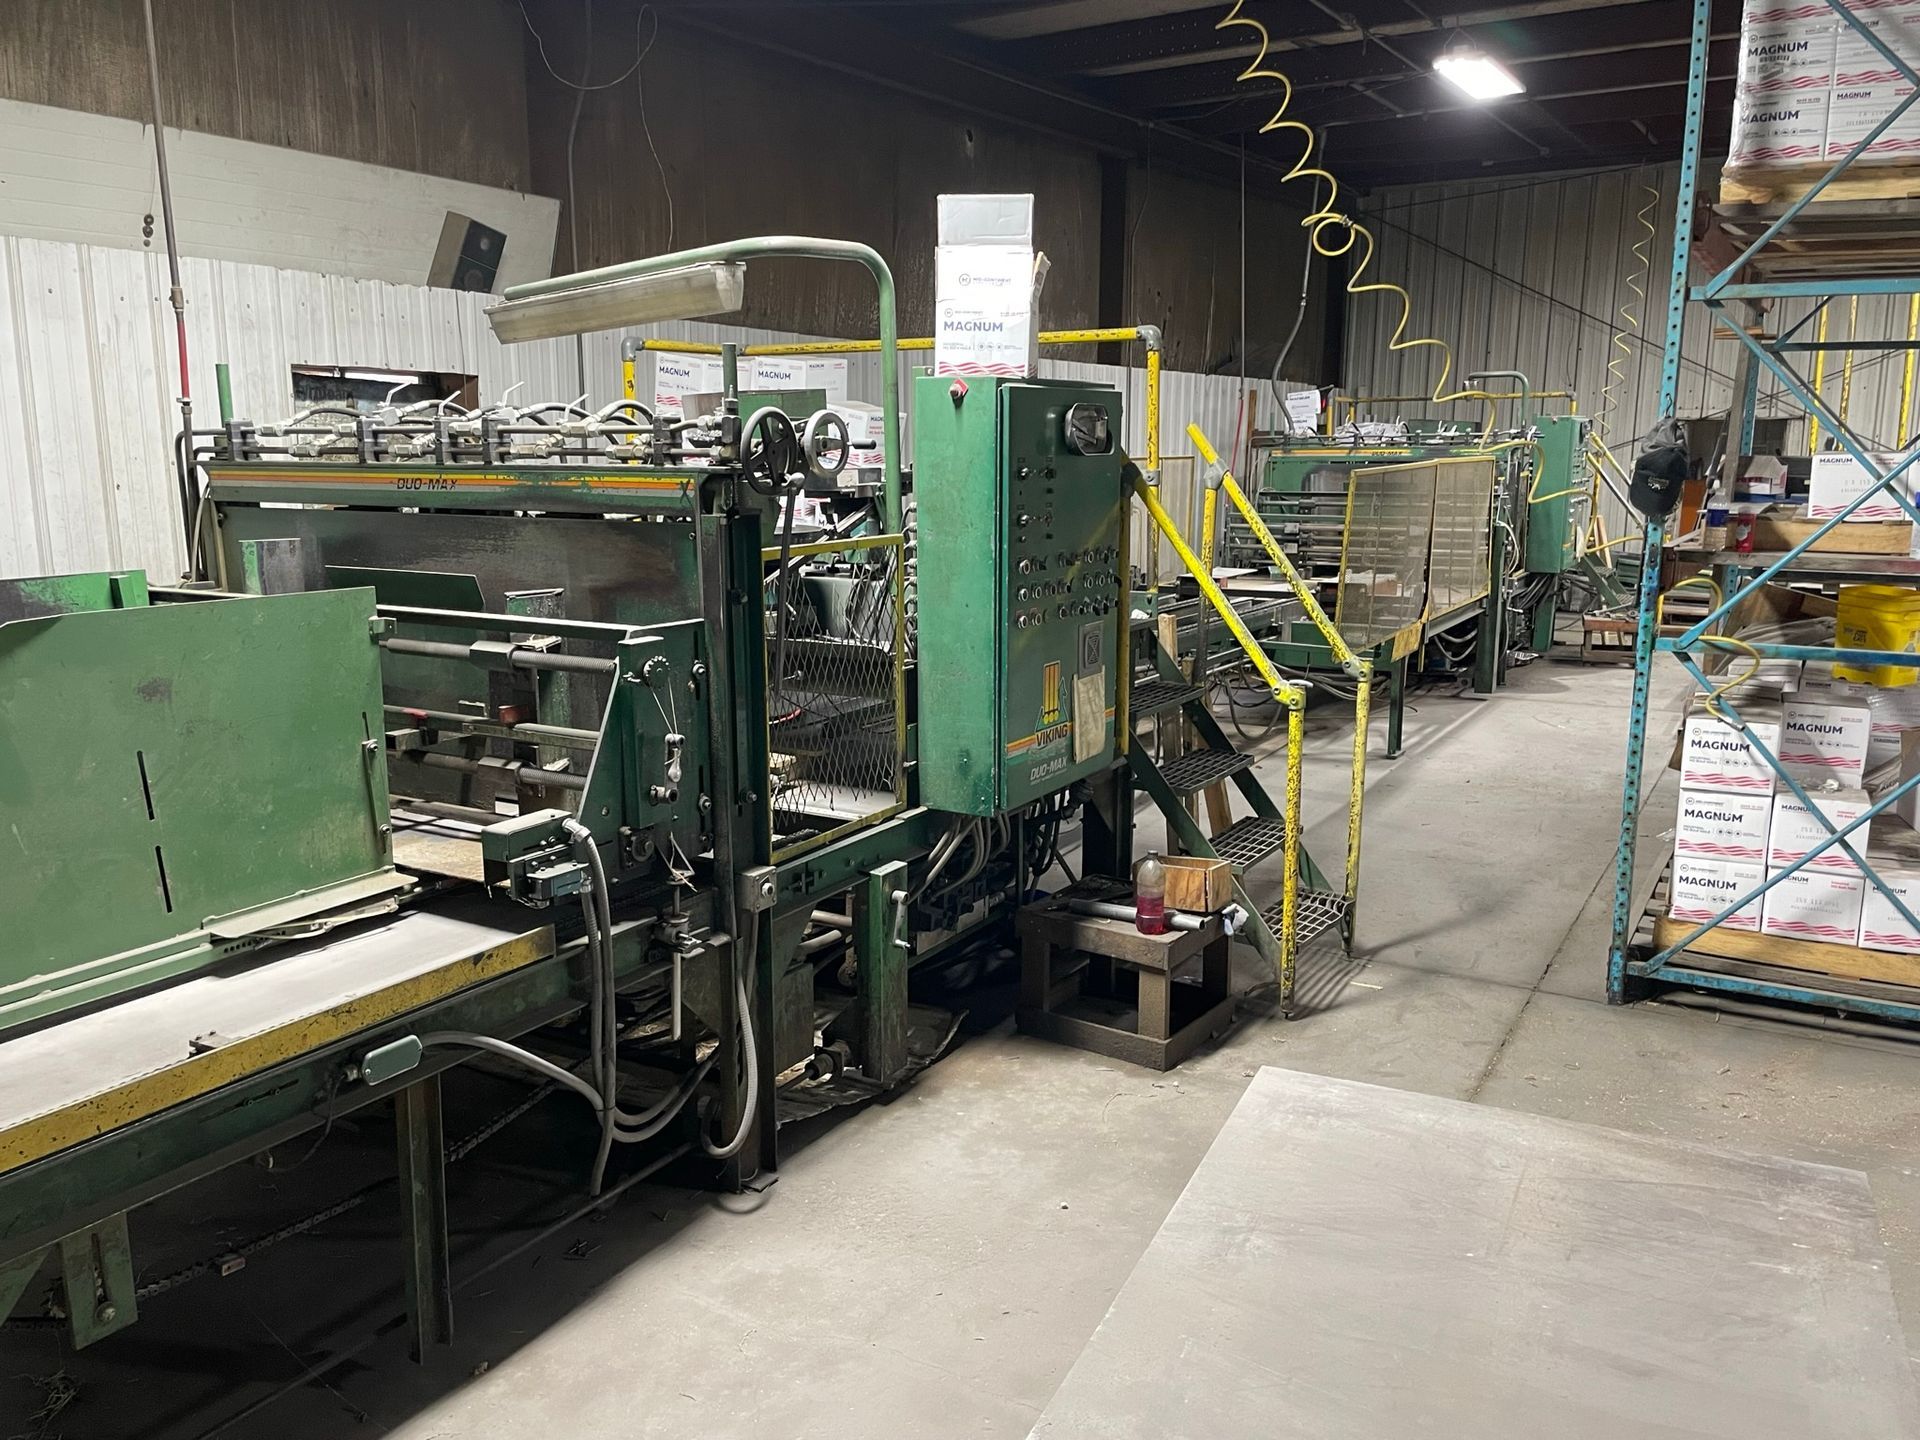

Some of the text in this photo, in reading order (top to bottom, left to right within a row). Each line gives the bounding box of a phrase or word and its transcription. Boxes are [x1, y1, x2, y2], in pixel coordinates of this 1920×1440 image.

[1748, 41, 1808, 57] MAGNUM
[1837, 91, 1871, 100] MAGNUM
[1739, 110, 1800, 125] MAGNUM
[943, 321, 1003, 332] MAGNUM
[659, 366, 690, 377] MAGNUM
[758, 370, 791, 380] MAGNUM
[397, 478, 458, 490] DUO-MAX
[1786, 722, 1843, 734] MAGNUM
[1036, 724, 1068, 747] VIKING
[1691, 739, 1751, 752] MAGNUM
[1030, 756, 1068, 781] DUO-MAX
[1781, 804, 1811, 812] MAGNU
[1684, 808, 1743, 823] MAGNUM
[1679, 875, 1737, 891] MAGNUM
[1873, 886, 1906, 894] MNUM
